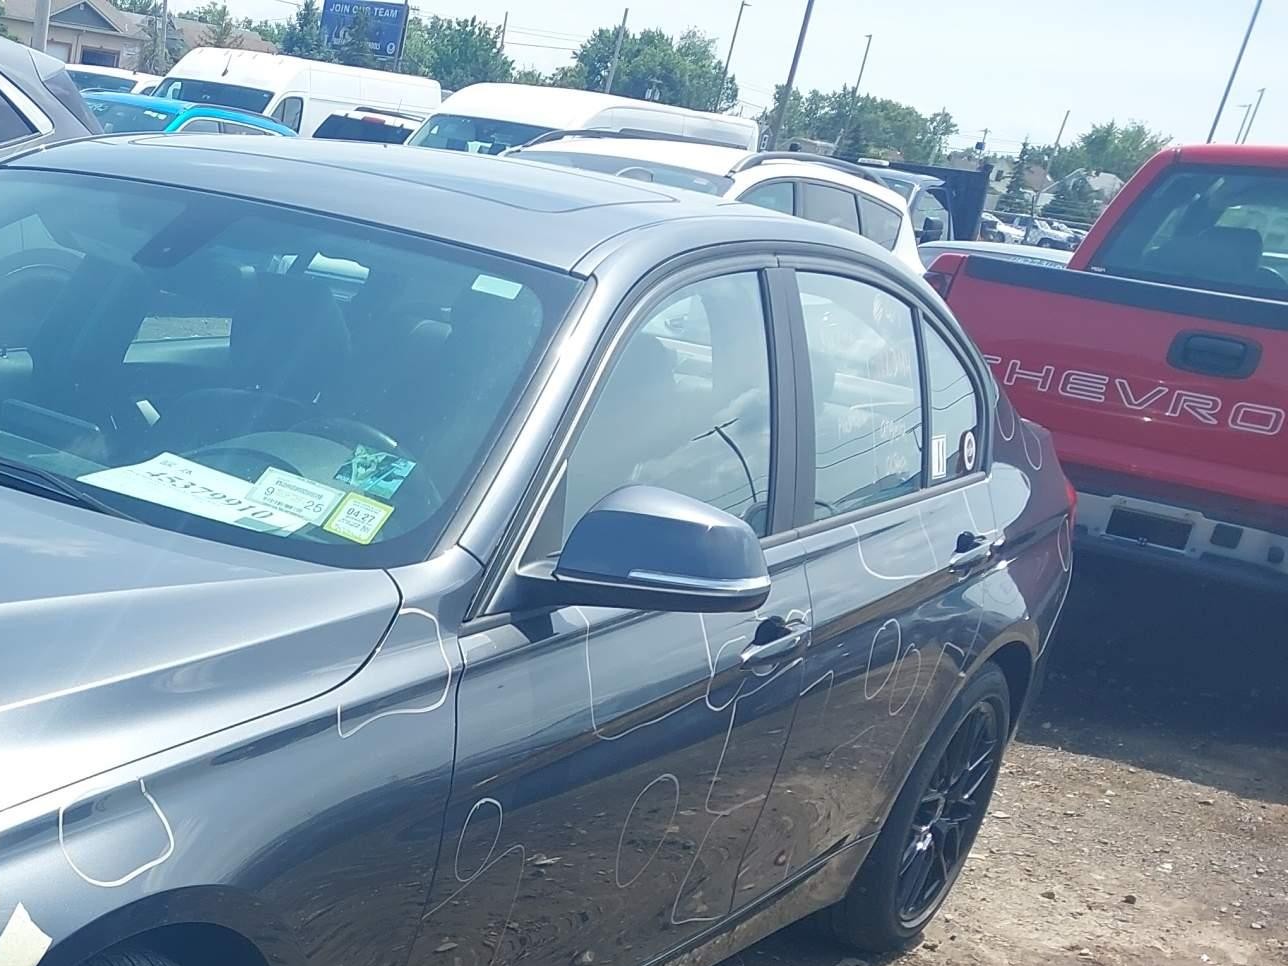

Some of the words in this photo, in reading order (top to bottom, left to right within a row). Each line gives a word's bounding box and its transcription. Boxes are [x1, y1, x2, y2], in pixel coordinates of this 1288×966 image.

[329, 3, 350, 14] JOIN
[374, 7, 398, 18] TEAM
[346, 507, 376, 523] 0427
